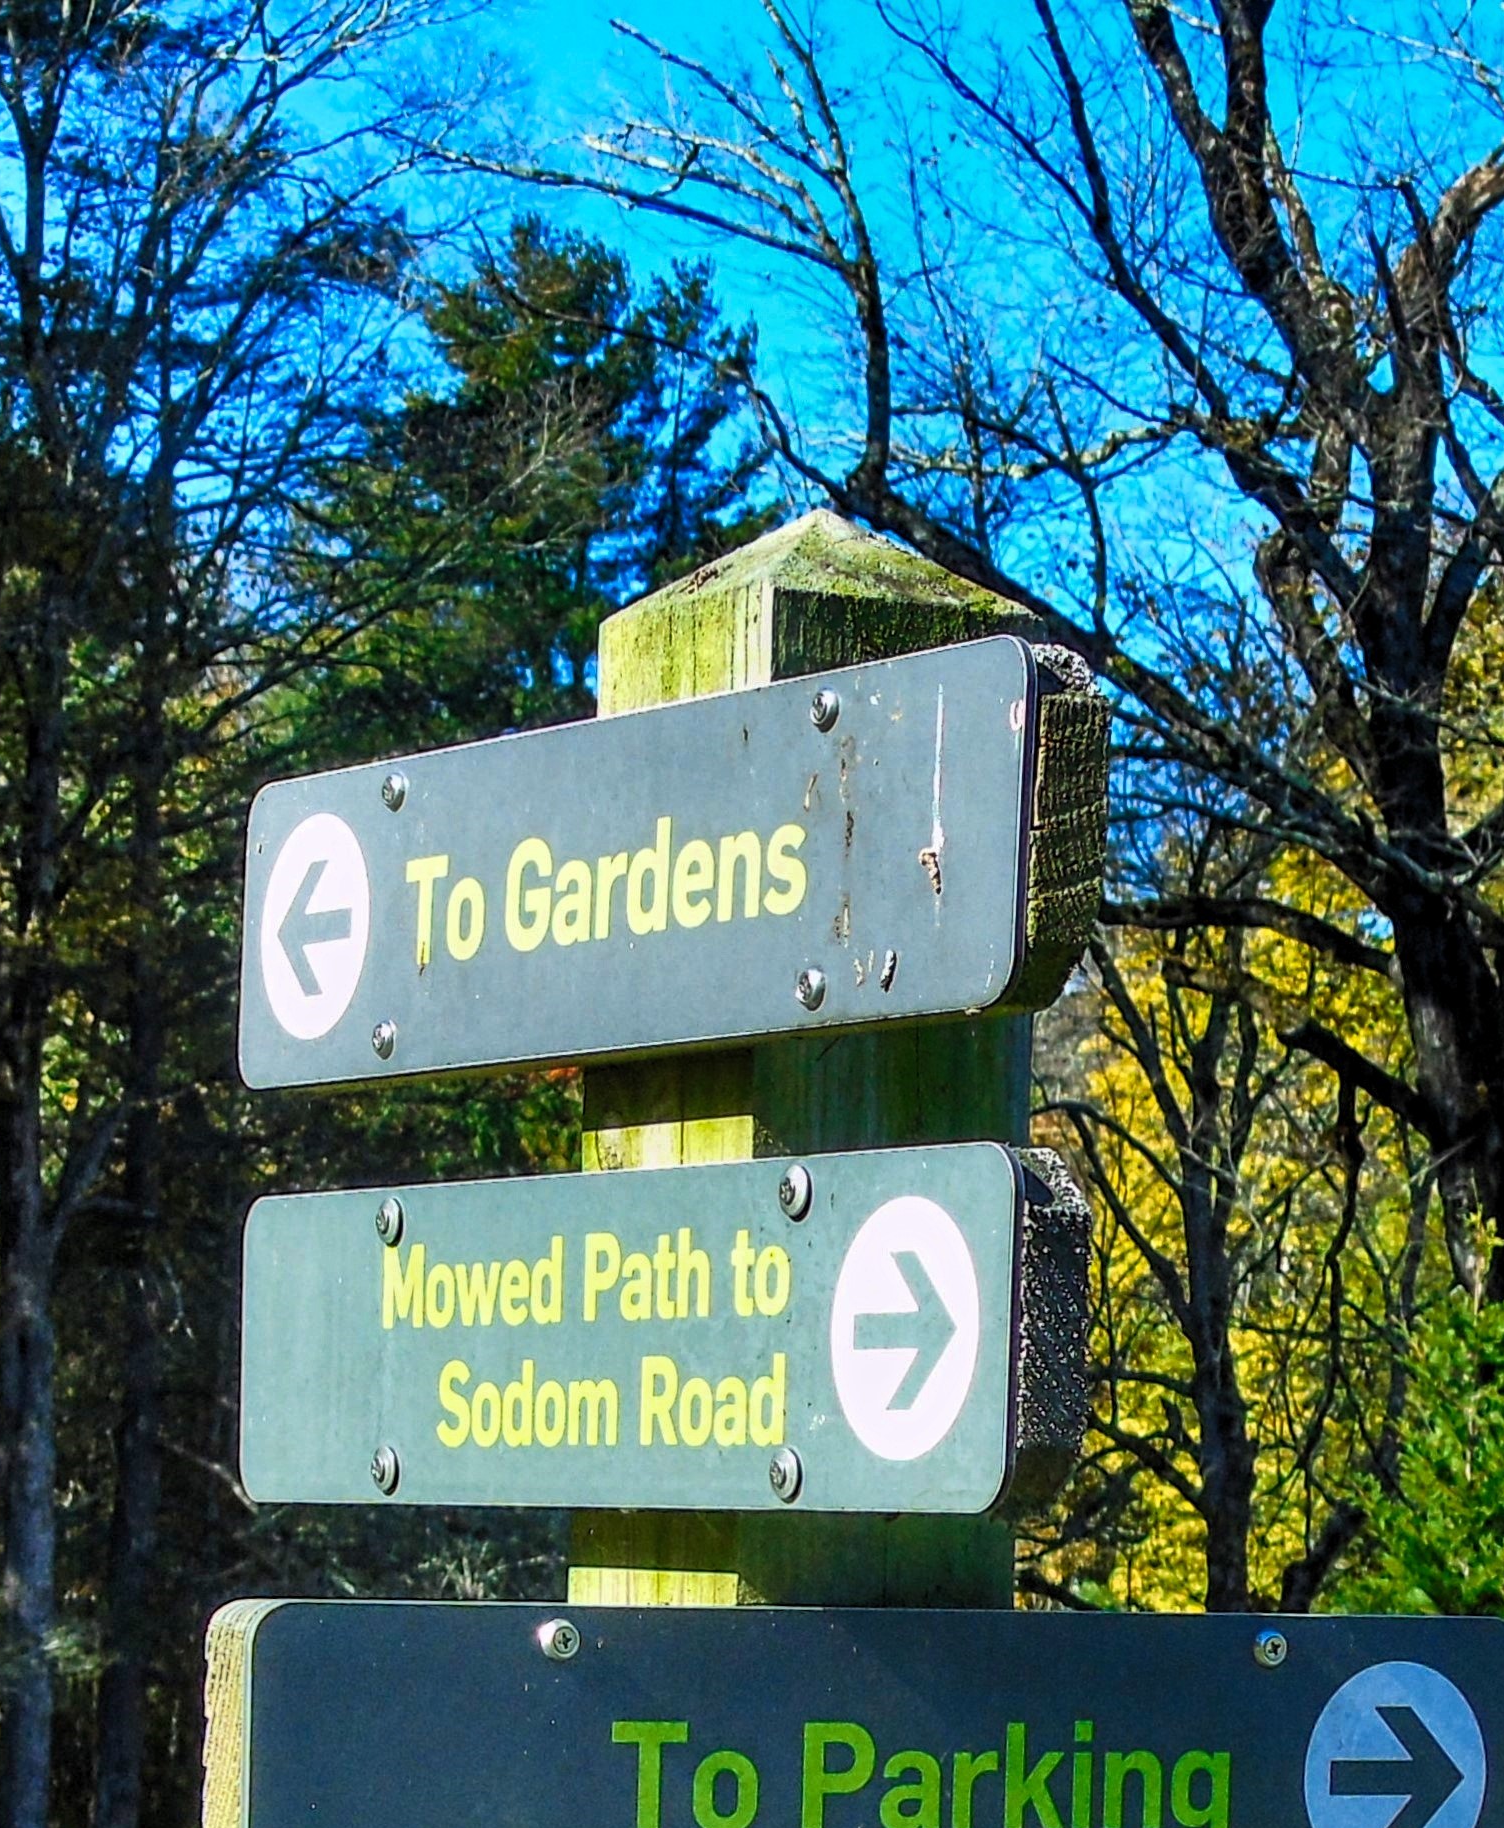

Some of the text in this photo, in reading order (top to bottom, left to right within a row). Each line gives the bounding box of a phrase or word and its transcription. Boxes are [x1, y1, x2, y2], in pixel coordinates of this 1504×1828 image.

[406, 816, 808, 967] To Gardens
[381, 1227, 791, 1331] Mowed Path to
[436, 1353, 787, 1448] Sodom Road
